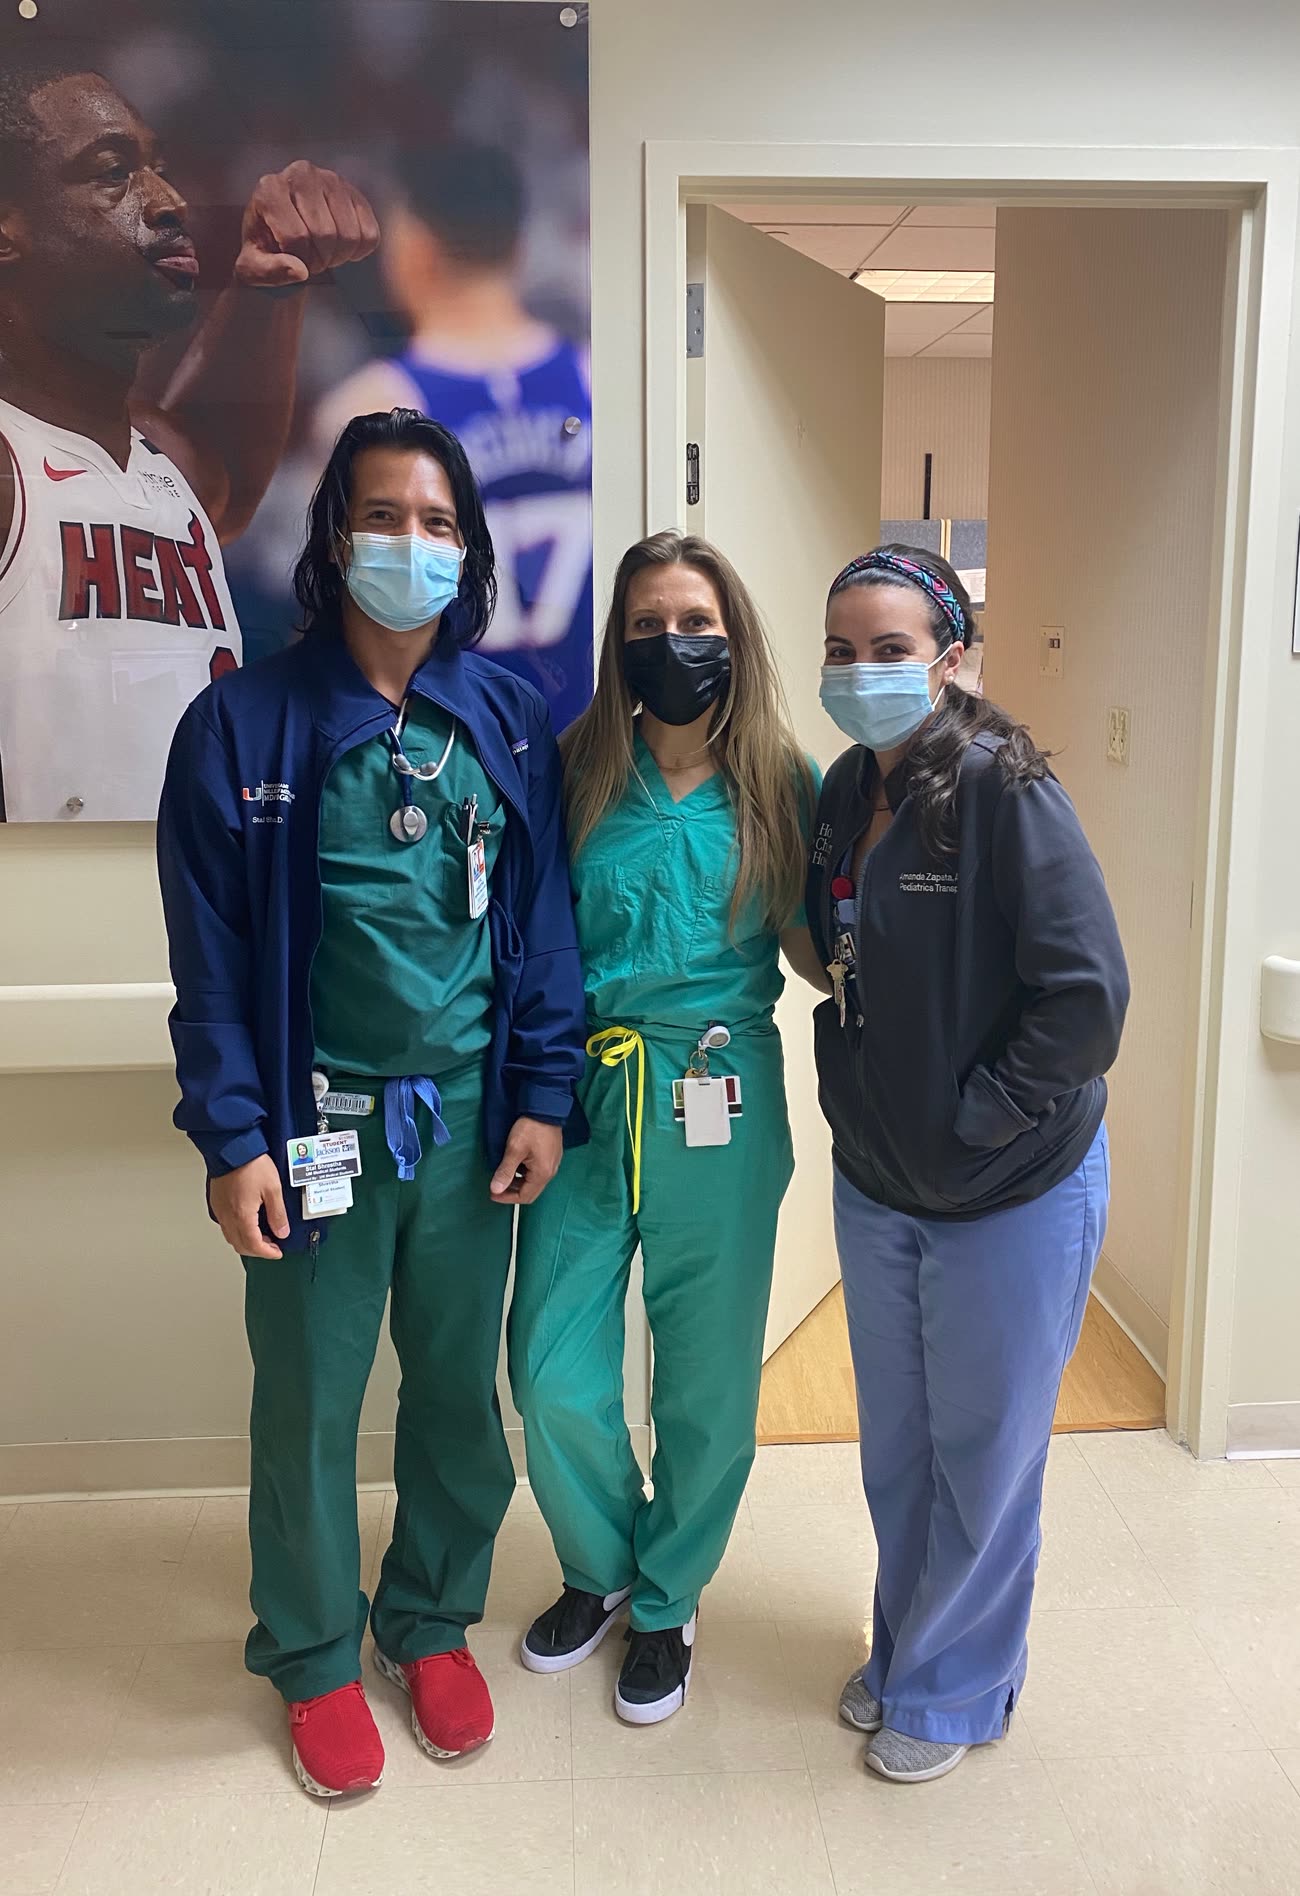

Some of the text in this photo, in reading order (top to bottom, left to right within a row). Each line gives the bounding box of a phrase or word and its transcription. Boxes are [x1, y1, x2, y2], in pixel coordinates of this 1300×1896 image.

[58, 508, 227, 632] HEAT
[819, 823, 833, 838] Ho
[899, 882, 934, 892] Pediatrics
[322, 1140, 347, 1148] STUDENT
[315, 1146, 340, 1158] Jackson
[317, 1161, 342, 1170] Shrestha
